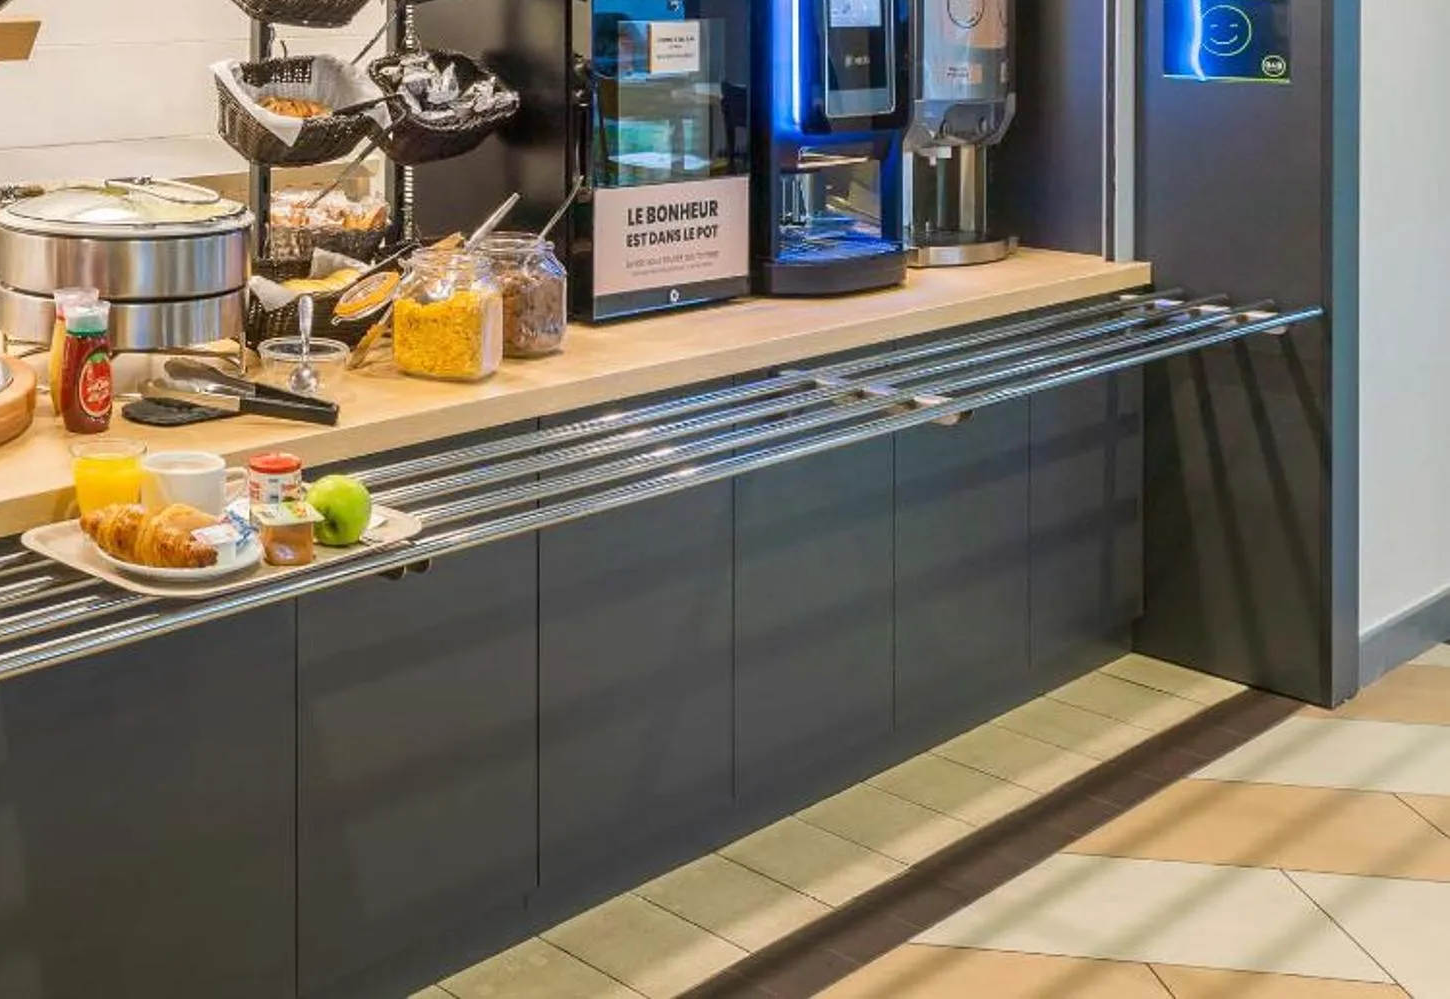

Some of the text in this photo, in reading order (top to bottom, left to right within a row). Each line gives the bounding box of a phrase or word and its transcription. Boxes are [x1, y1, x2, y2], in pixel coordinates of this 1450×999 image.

[628, 200, 718, 226] LE BONHEUR
[626, 225, 719, 247] EST DANS LE POT
